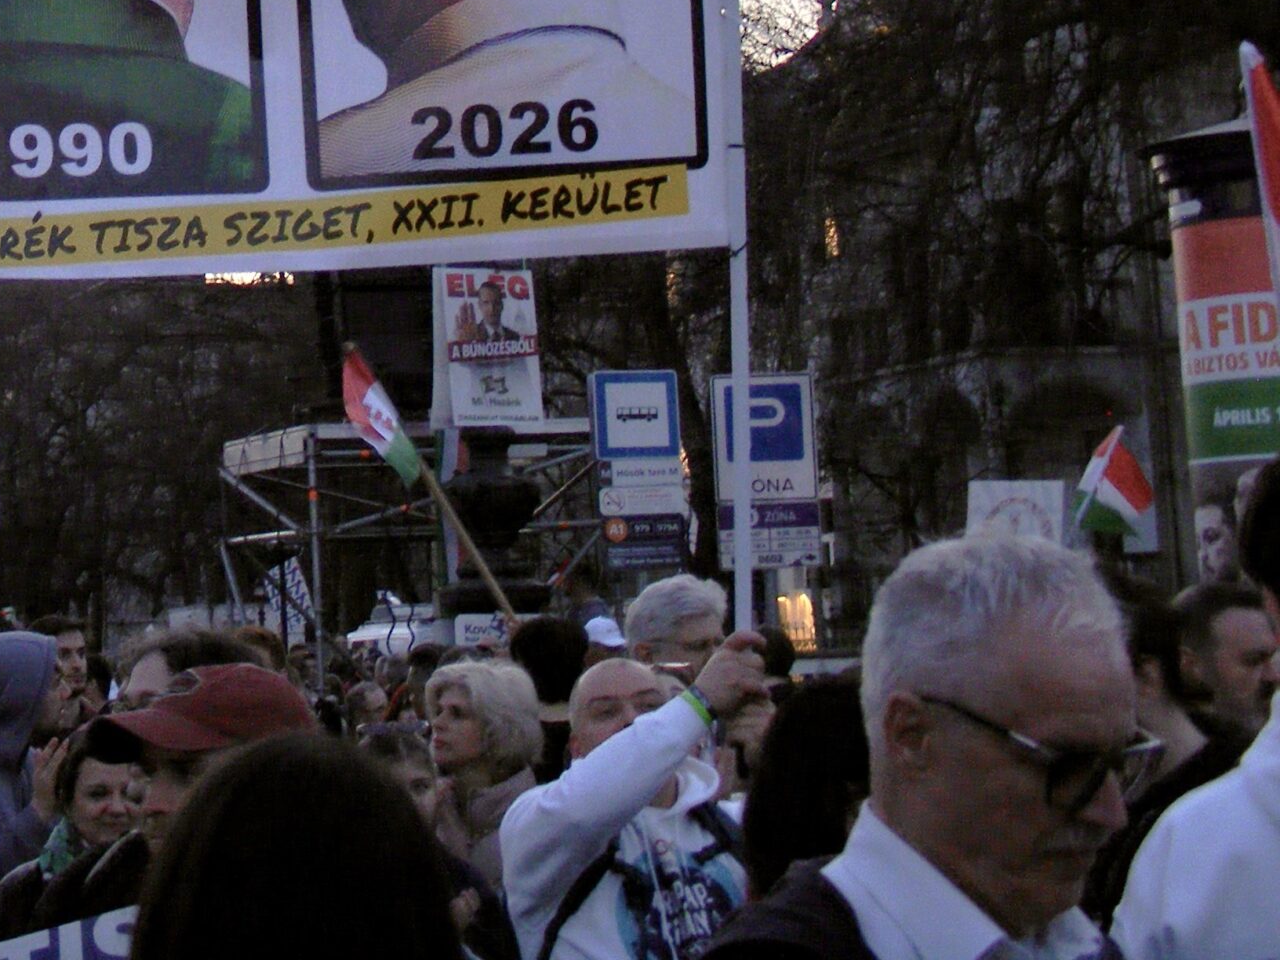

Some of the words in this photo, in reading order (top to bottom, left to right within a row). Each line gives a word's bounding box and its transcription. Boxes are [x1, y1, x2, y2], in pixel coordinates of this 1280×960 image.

[411, 99, 599, 160] 2026
[90, 216, 208, 254] TISZA
[224, 202, 374, 247] SZIGET,
[392, 193, 484, 235] XXII.
[502, 173, 668, 224] KERÜLET
[1185, 310, 1202, 351] A
[1207, 301, 1278, 349] FID
[452, 345, 460, 358] A
[1194, 352, 1249, 375] BIZTOS
[751, 473, 794, 493] ÓNA
